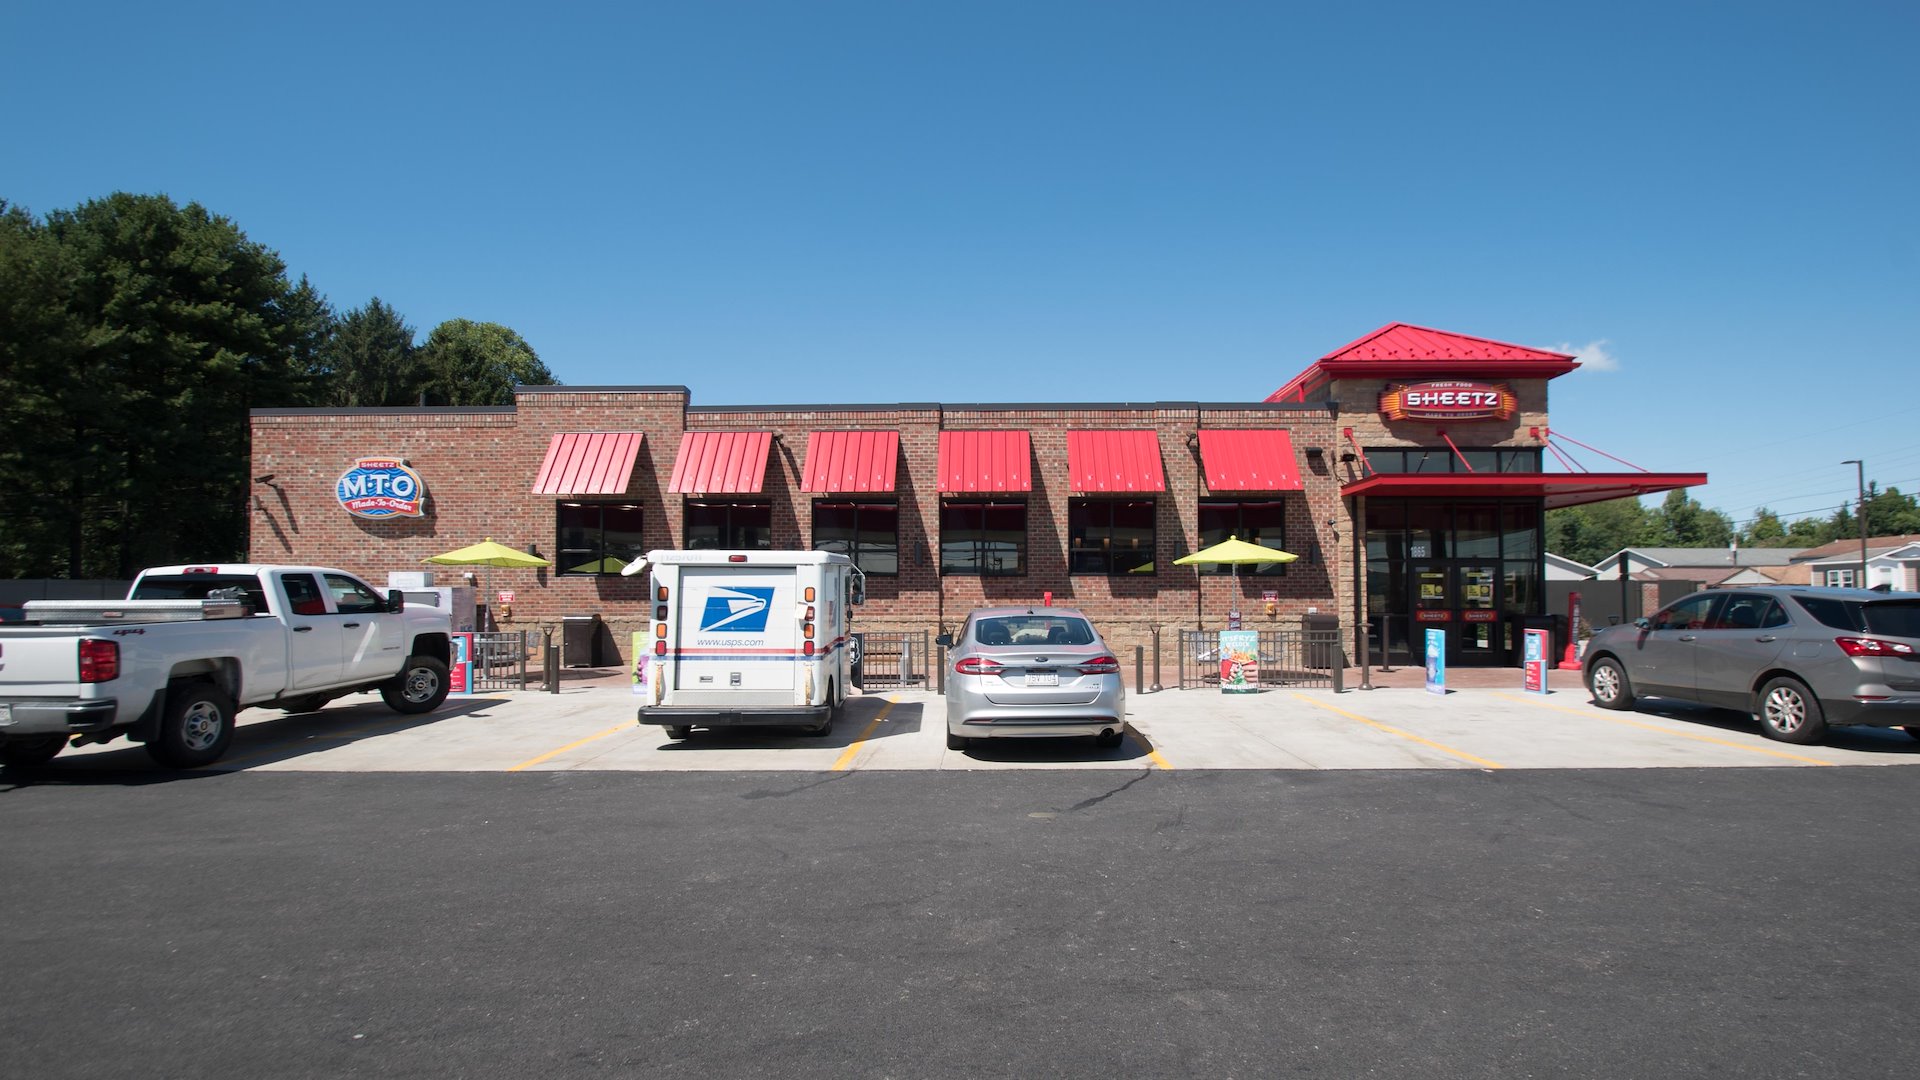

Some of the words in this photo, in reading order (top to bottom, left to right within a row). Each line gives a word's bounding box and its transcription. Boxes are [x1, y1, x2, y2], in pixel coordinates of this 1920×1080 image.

[1407, 391, 1498, 406] SHEETZ
[352, 499, 412, 512] Made-To-Order
[697, 639, 764, 647] www.usps.com
